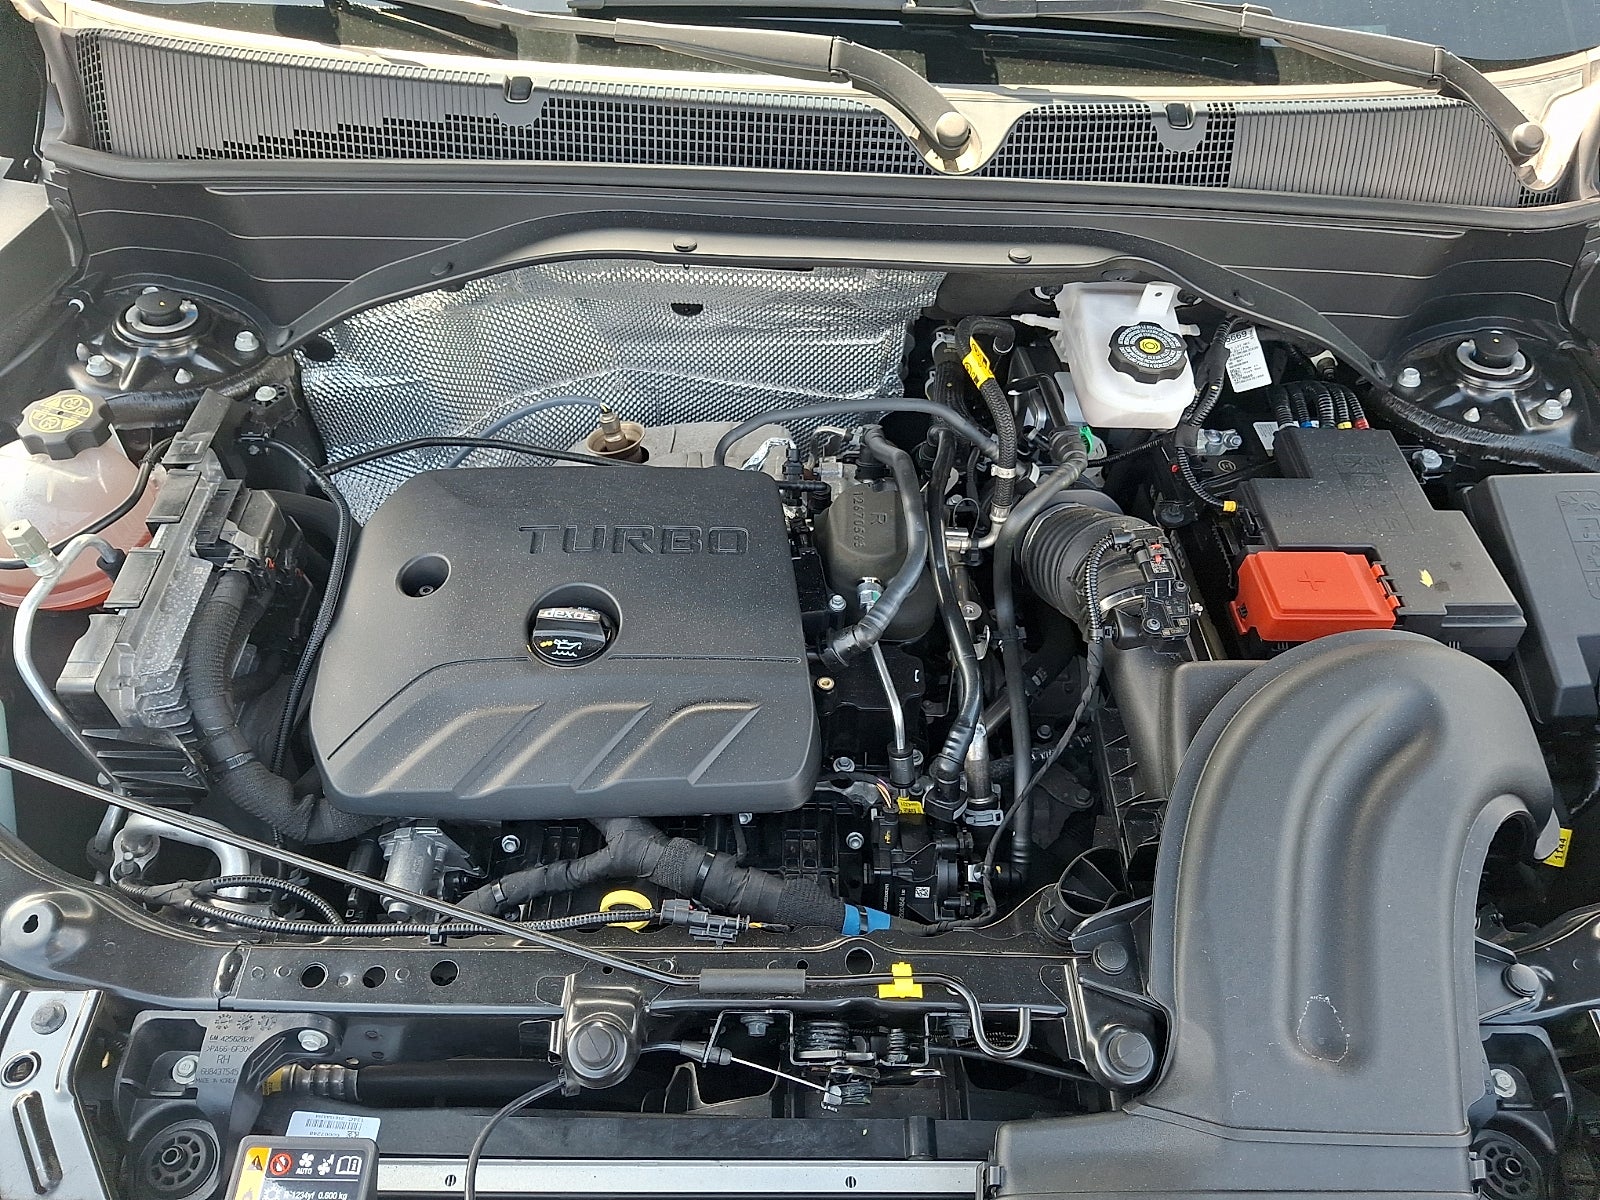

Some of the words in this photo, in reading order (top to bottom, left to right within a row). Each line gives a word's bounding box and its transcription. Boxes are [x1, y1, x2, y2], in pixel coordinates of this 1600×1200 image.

[519, 525, 749, 554] TURBO
[543, 608, 595, 620] dexos
[216, 1054, 231, 1064] RH
[295, 1167, 313, 1175] AUTO
[338, 1191, 348, 1200] kg
